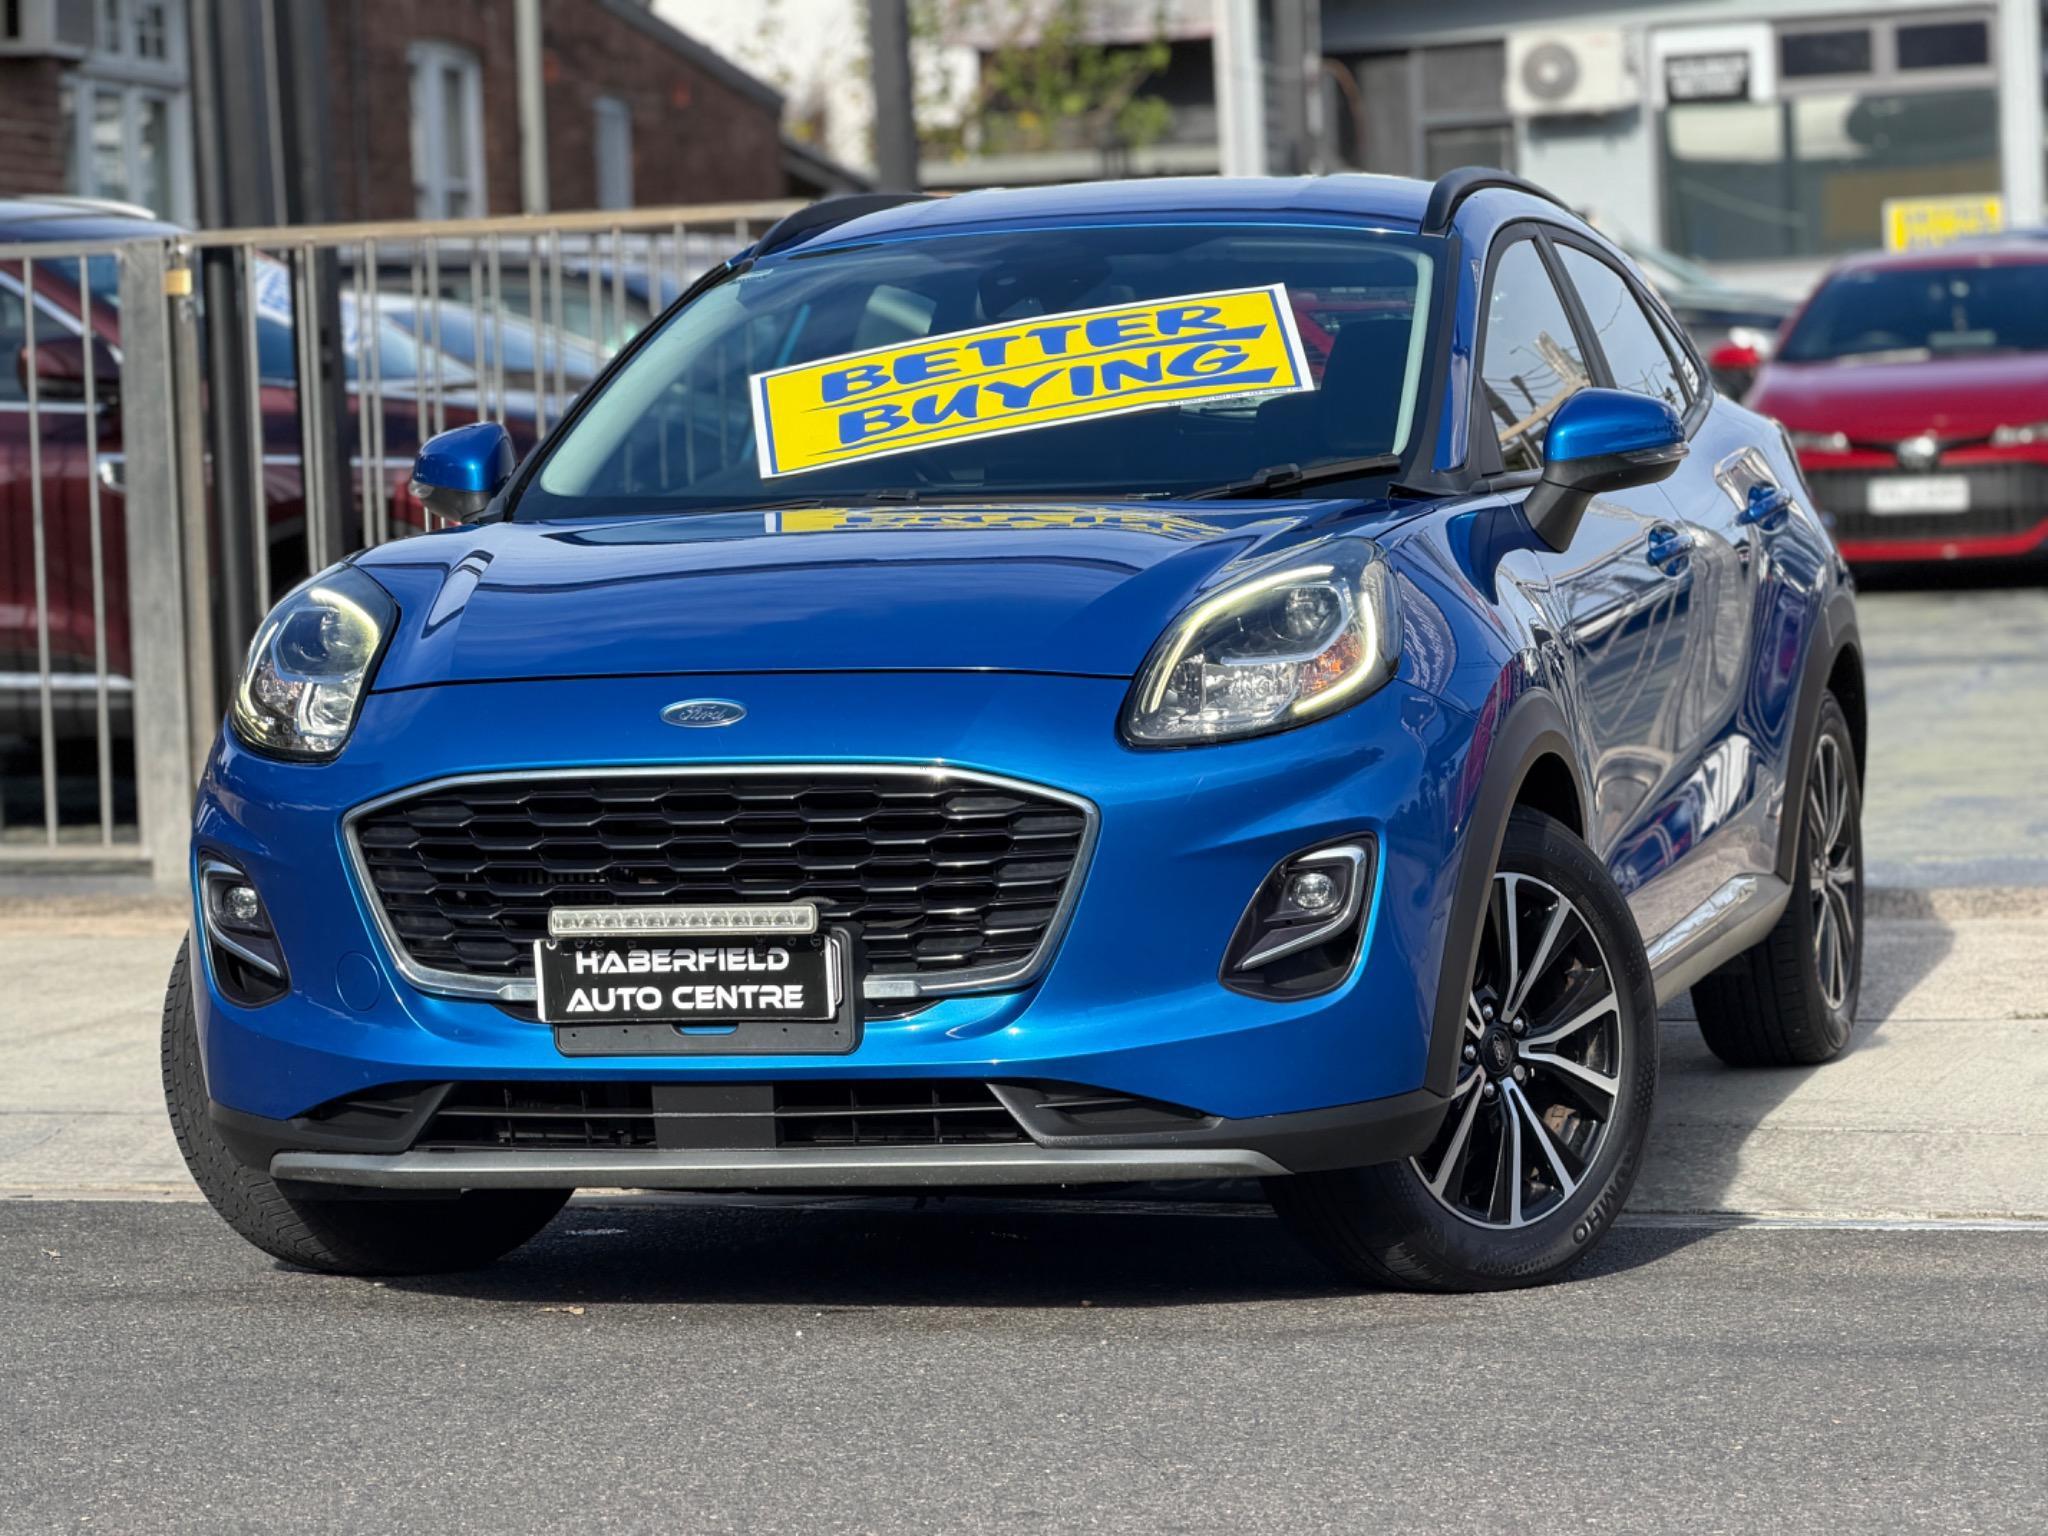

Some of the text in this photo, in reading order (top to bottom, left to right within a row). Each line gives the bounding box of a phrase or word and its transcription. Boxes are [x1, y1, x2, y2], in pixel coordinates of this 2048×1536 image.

[822, 306, 1227, 403] BETTER
[838, 343, 1250, 444] BUYING
[679, 704, 728, 721] Ford
[575, 947, 790, 974] HABERFIELD
[566, 985, 804, 1012] AUTO CENTRE
